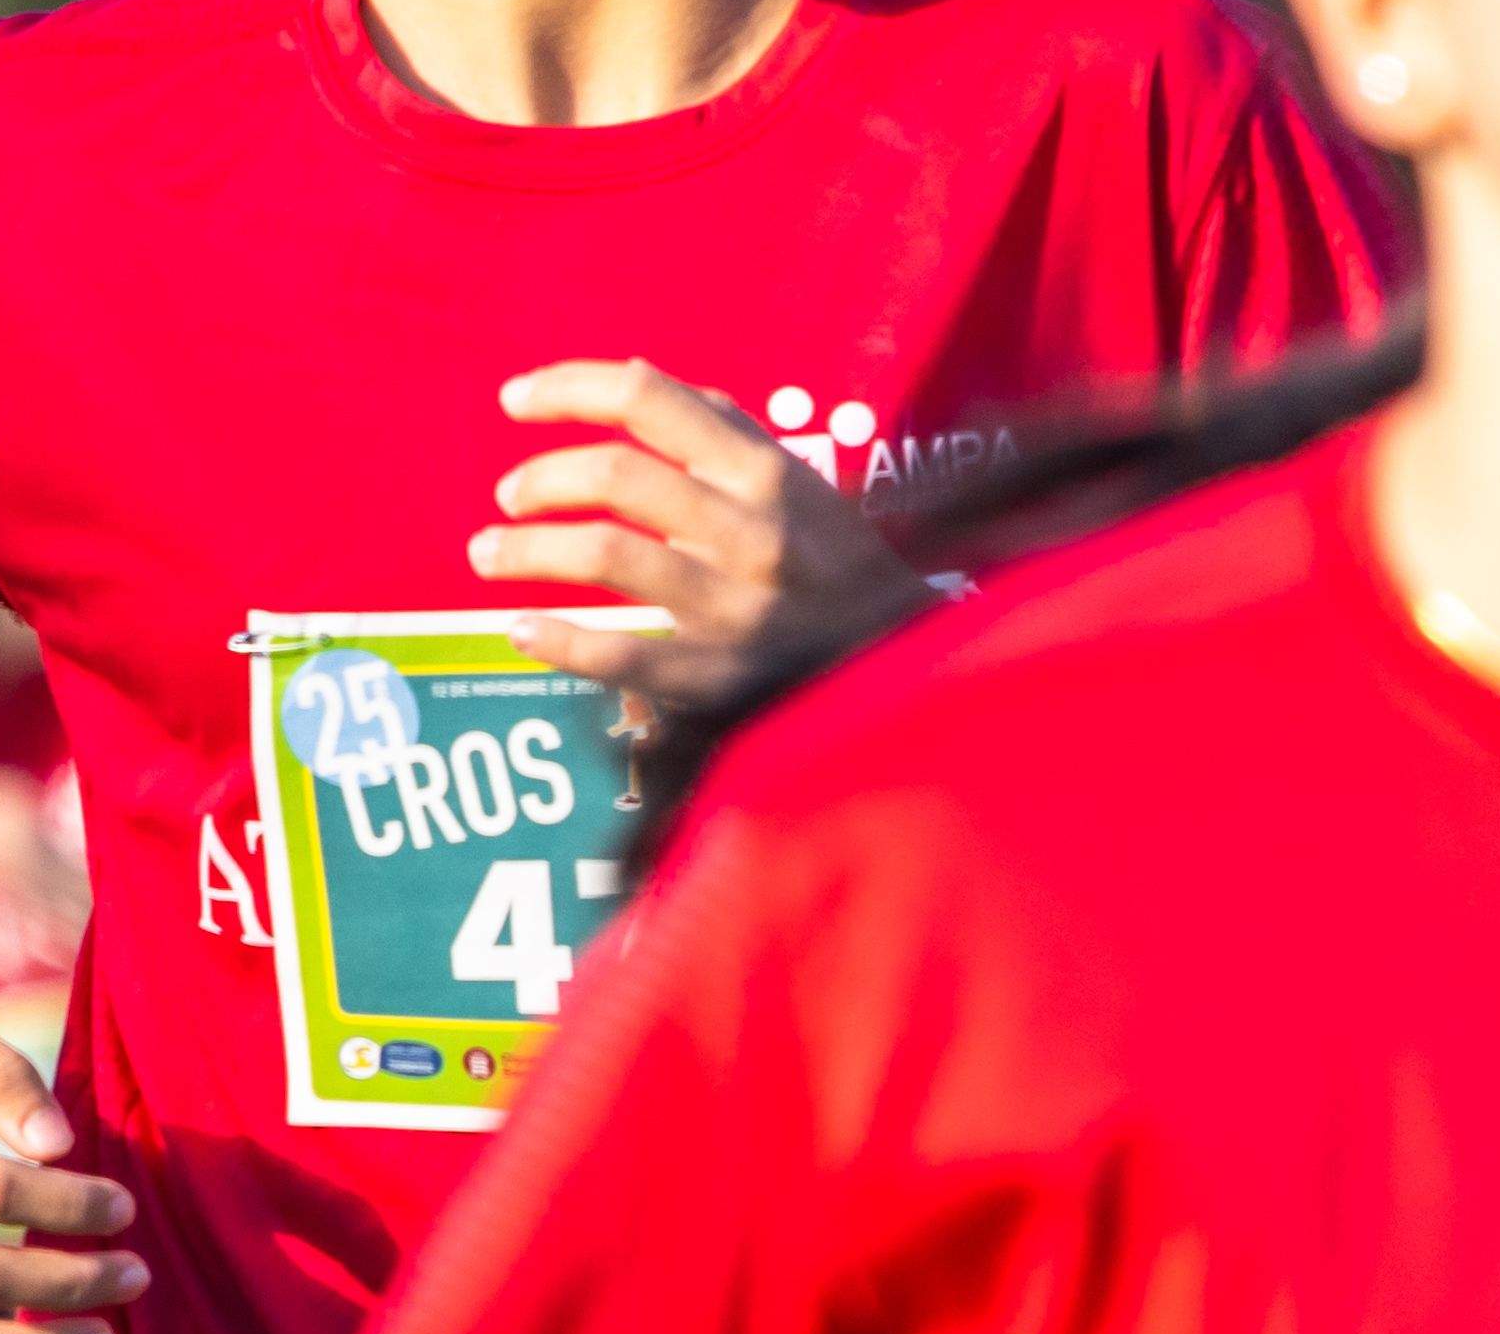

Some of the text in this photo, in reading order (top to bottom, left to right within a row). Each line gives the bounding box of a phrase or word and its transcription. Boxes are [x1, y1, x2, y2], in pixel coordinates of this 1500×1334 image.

[296, 659, 409, 779] 25
[336, 718, 575, 858] CROS
[451, 858, 622, 1015] 4
